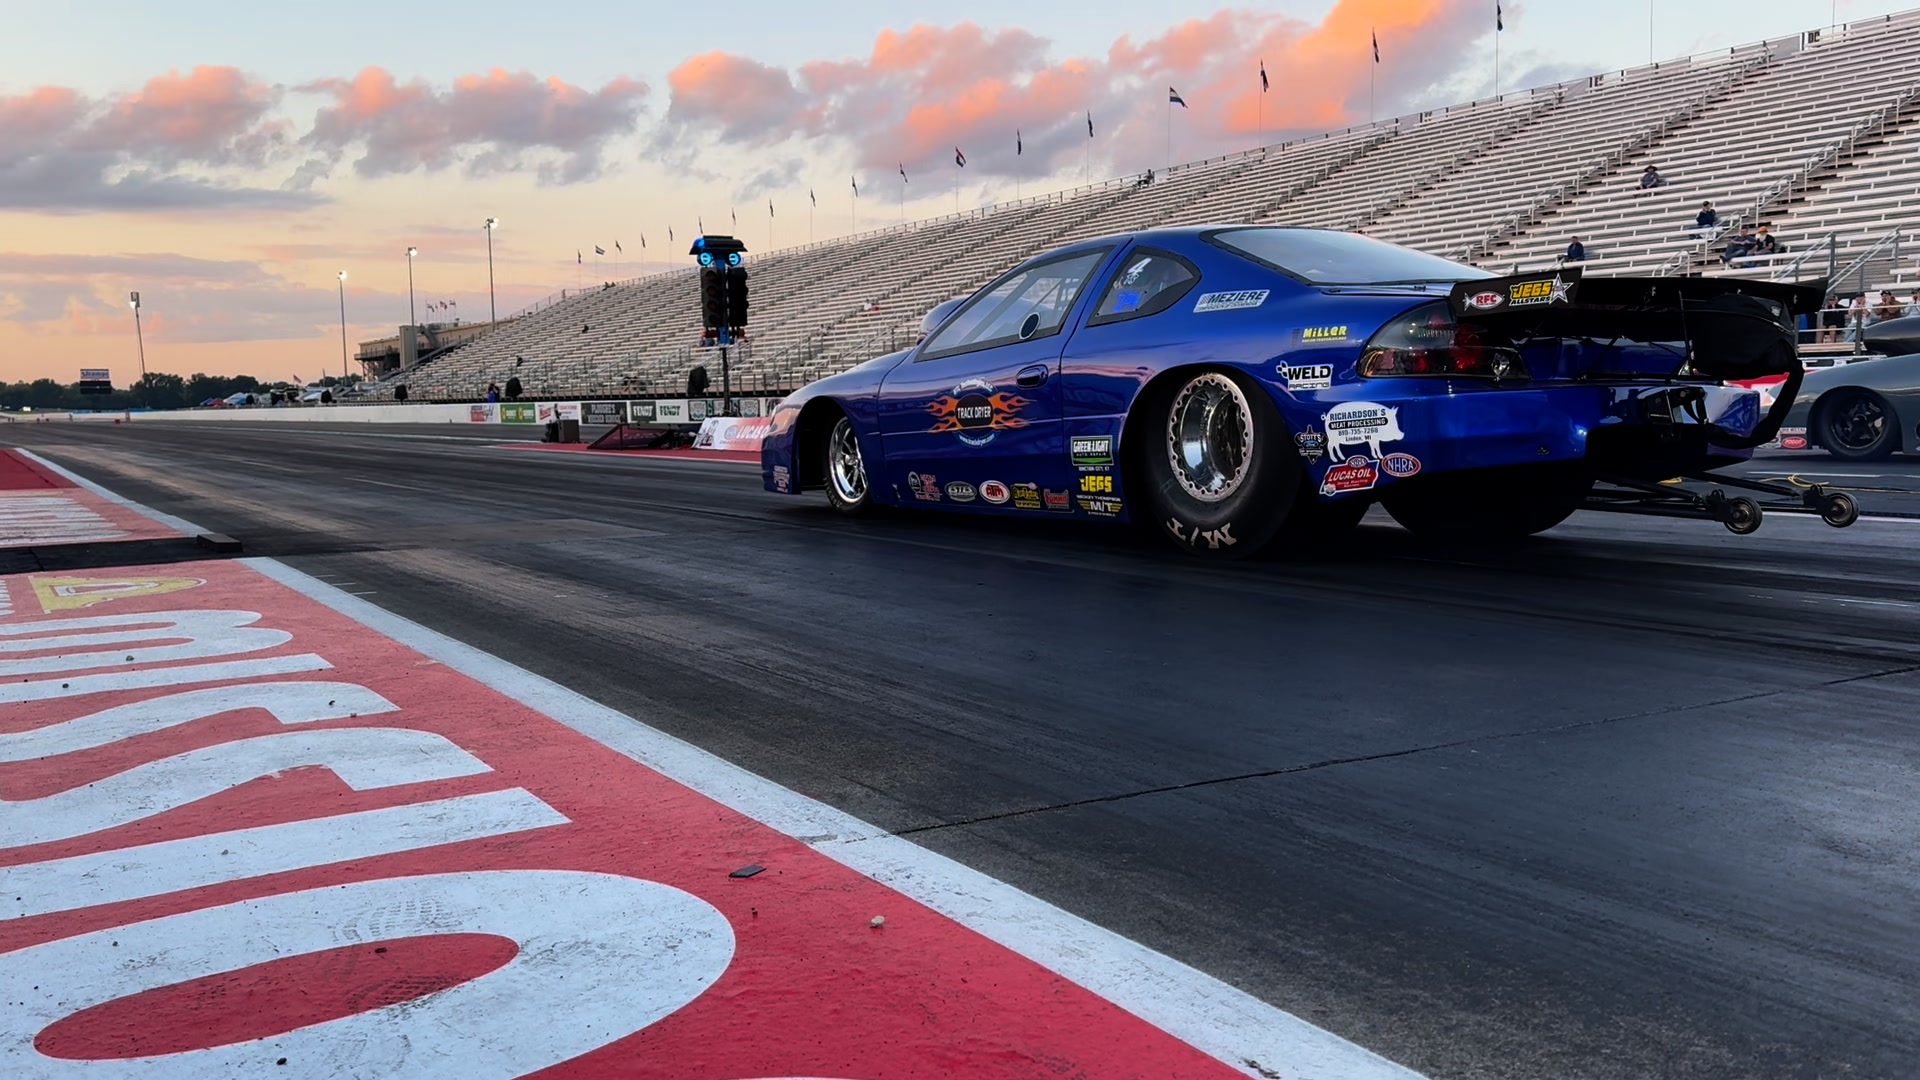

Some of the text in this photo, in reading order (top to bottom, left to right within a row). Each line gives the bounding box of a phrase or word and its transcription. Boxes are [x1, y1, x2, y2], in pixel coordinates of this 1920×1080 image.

[1512, 281, 1552, 298] JEGS
[1207, 290, 1267, 304] MEZIERE
[1476, 295, 1497, 304] RFC
[1511, 297, 1551, 305] ALLSTARS
[1287, 365, 1331, 380] WELD
[633, 405, 654, 416] FENDT
[660, 405, 681, 416] FENDT
[957, 406, 991, 419] TRACK DRYER
[1329, 408, 1386, 421] RICHARDSON'S
[1331, 418, 1386, 430] MEAT PROCESSING
[736, 425, 762, 440] LUCAS
[1387, 458, 1414, 472] NHRA
[1328, 468, 1372, 482] LUCAS OIL
[948, 486, 973, 494] ESTES
[1081, 475, 1112, 493] JEGS
[986, 484, 1004, 498] ATM
[1045, 491, 1070, 504] SUMMIT
[1089, 501, 1113, 512] M/T
